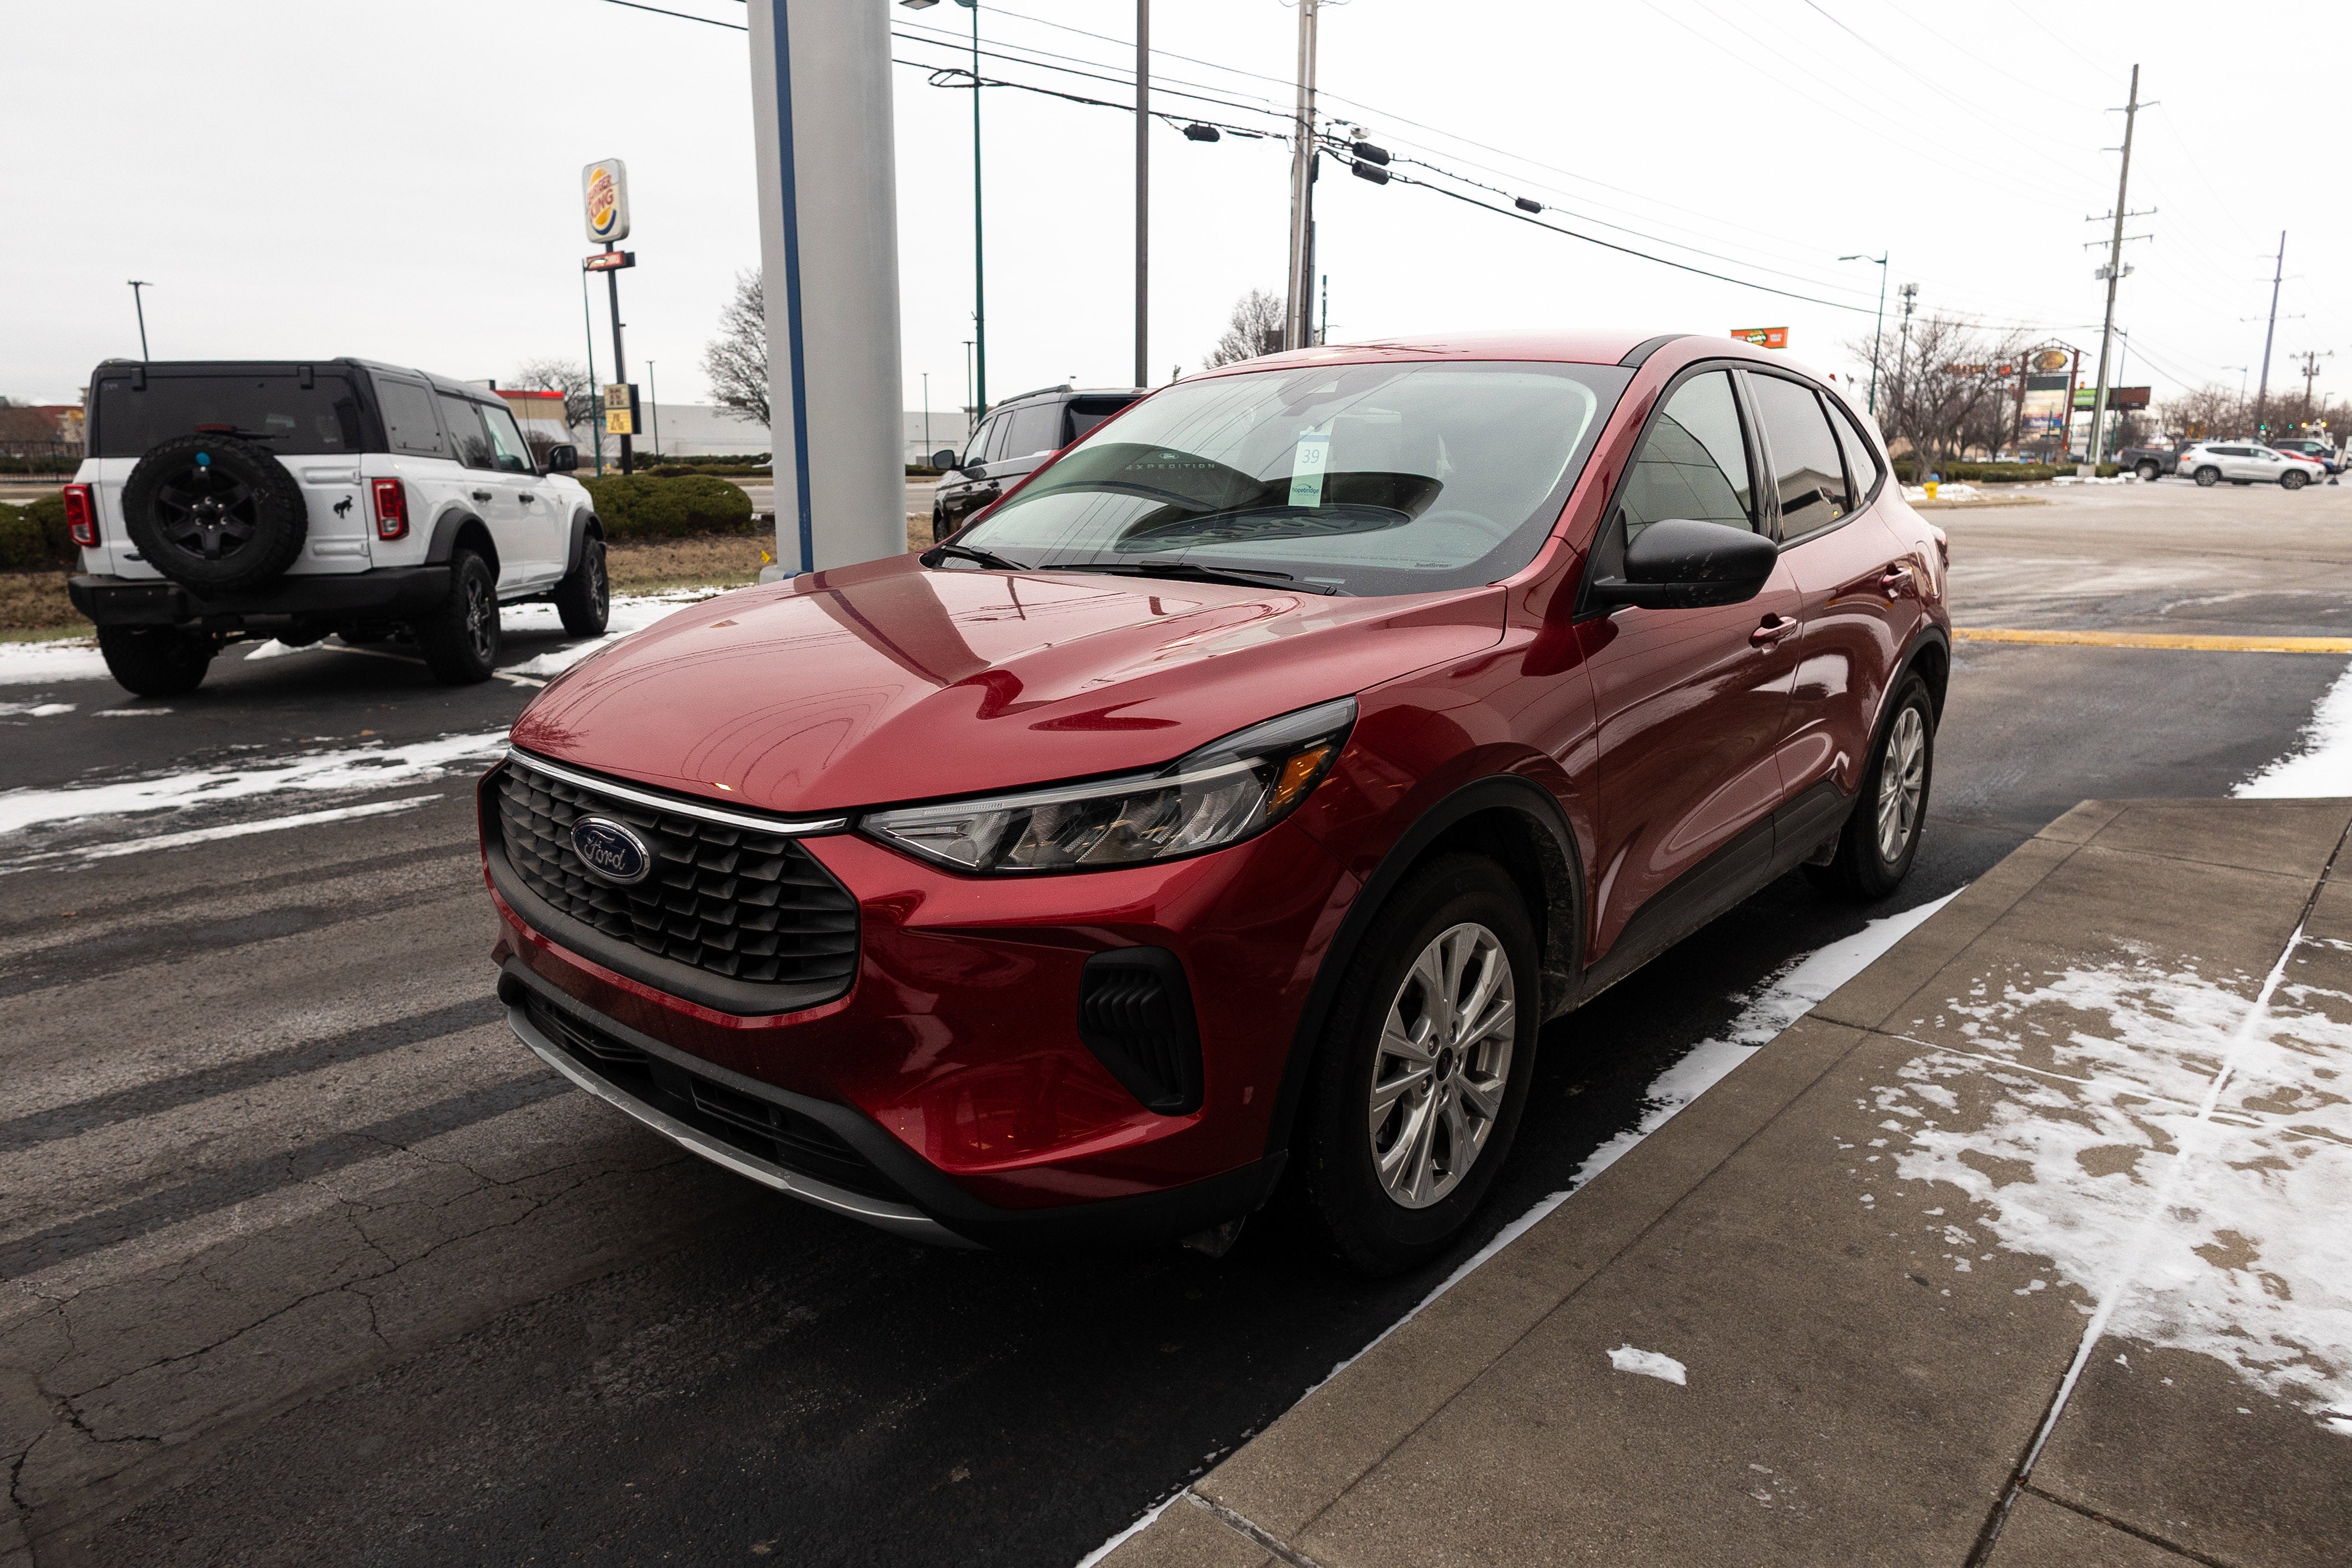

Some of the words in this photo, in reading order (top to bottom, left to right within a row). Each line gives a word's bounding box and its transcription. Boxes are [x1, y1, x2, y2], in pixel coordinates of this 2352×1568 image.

[589, 188, 613, 224] KING
[1302, 449, 1319, 463] 39
[1292, 486, 1319, 494] hopebridge
[584, 830, 625, 870] Ford
